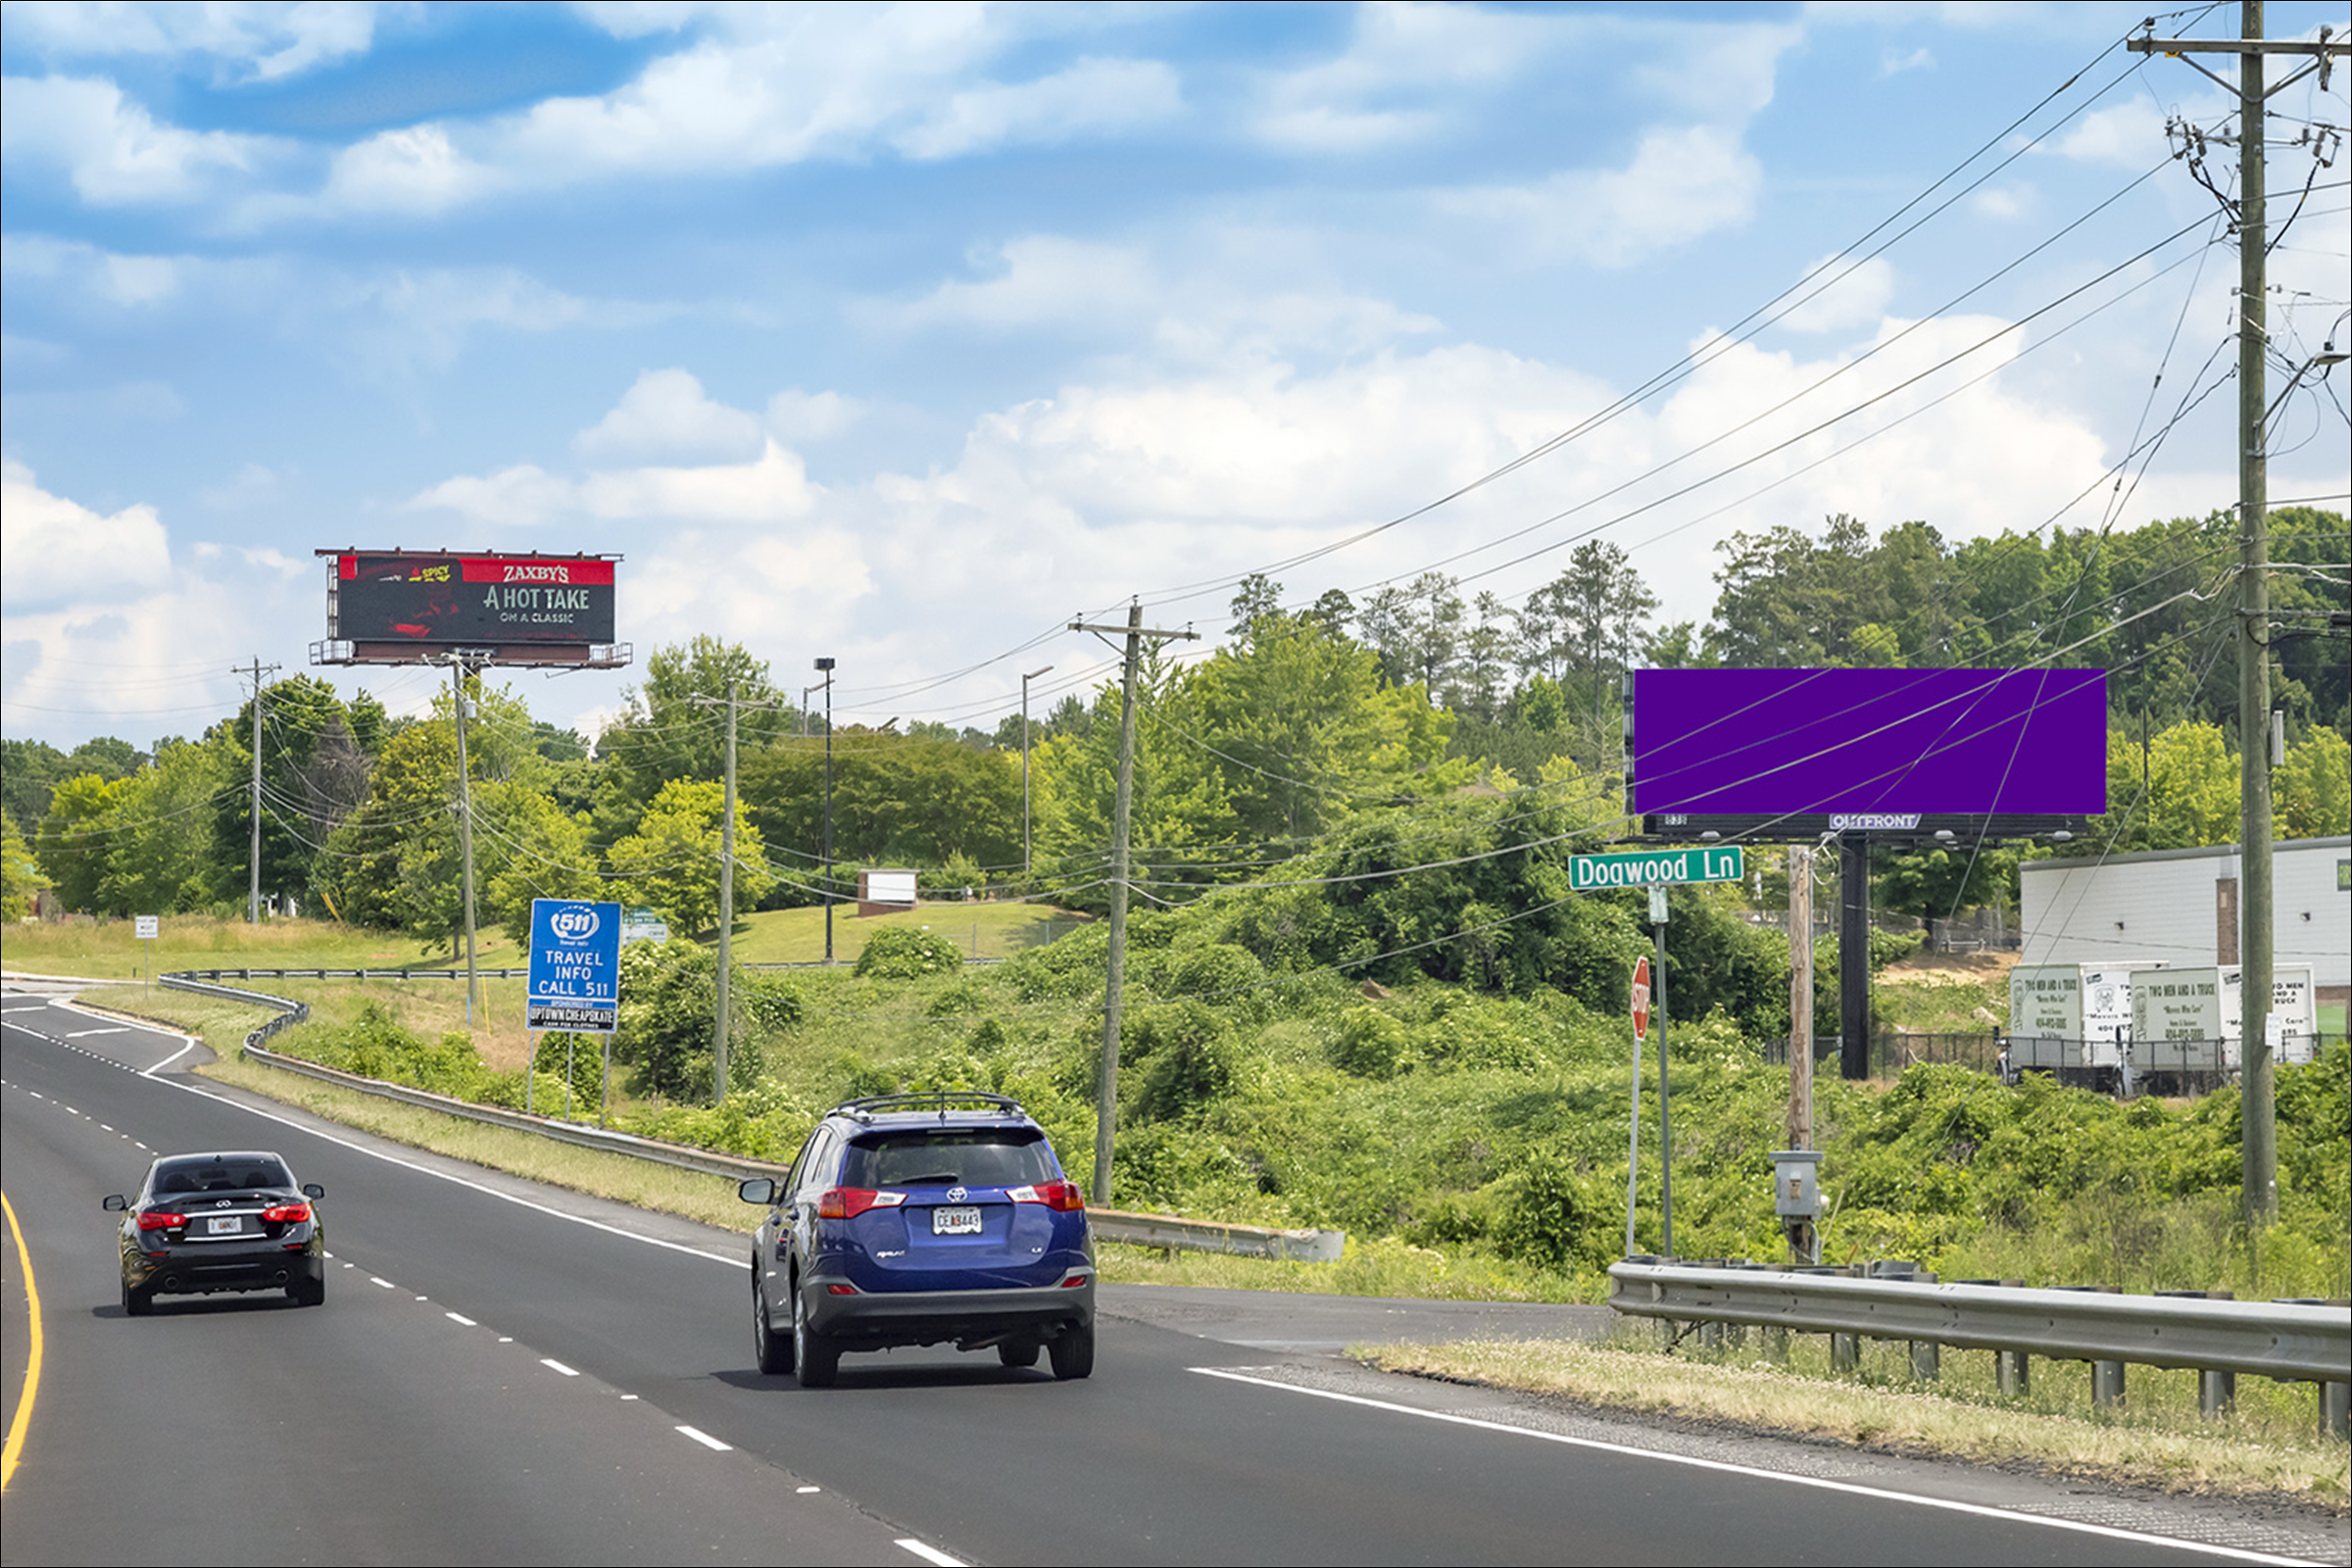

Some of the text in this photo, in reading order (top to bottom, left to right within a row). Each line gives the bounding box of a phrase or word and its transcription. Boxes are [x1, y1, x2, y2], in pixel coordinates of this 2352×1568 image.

[503, 564, 569, 584] ZAXBY'S
[483, 585, 590, 611] A HOT TAKE
[520, 612, 529, 623] A
[531, 612, 574, 624] CLASSIC
[1578, 851, 1735, 887] Dogwood Ln
[559, 913, 591, 932] 511
[546, 950, 604, 967] TRAVEL
[556, 966, 592, 981] INFO
[538, 980, 609, 997] CALL 511
[2149, 983, 2216, 998] TWO MEN AND A TRUCK
